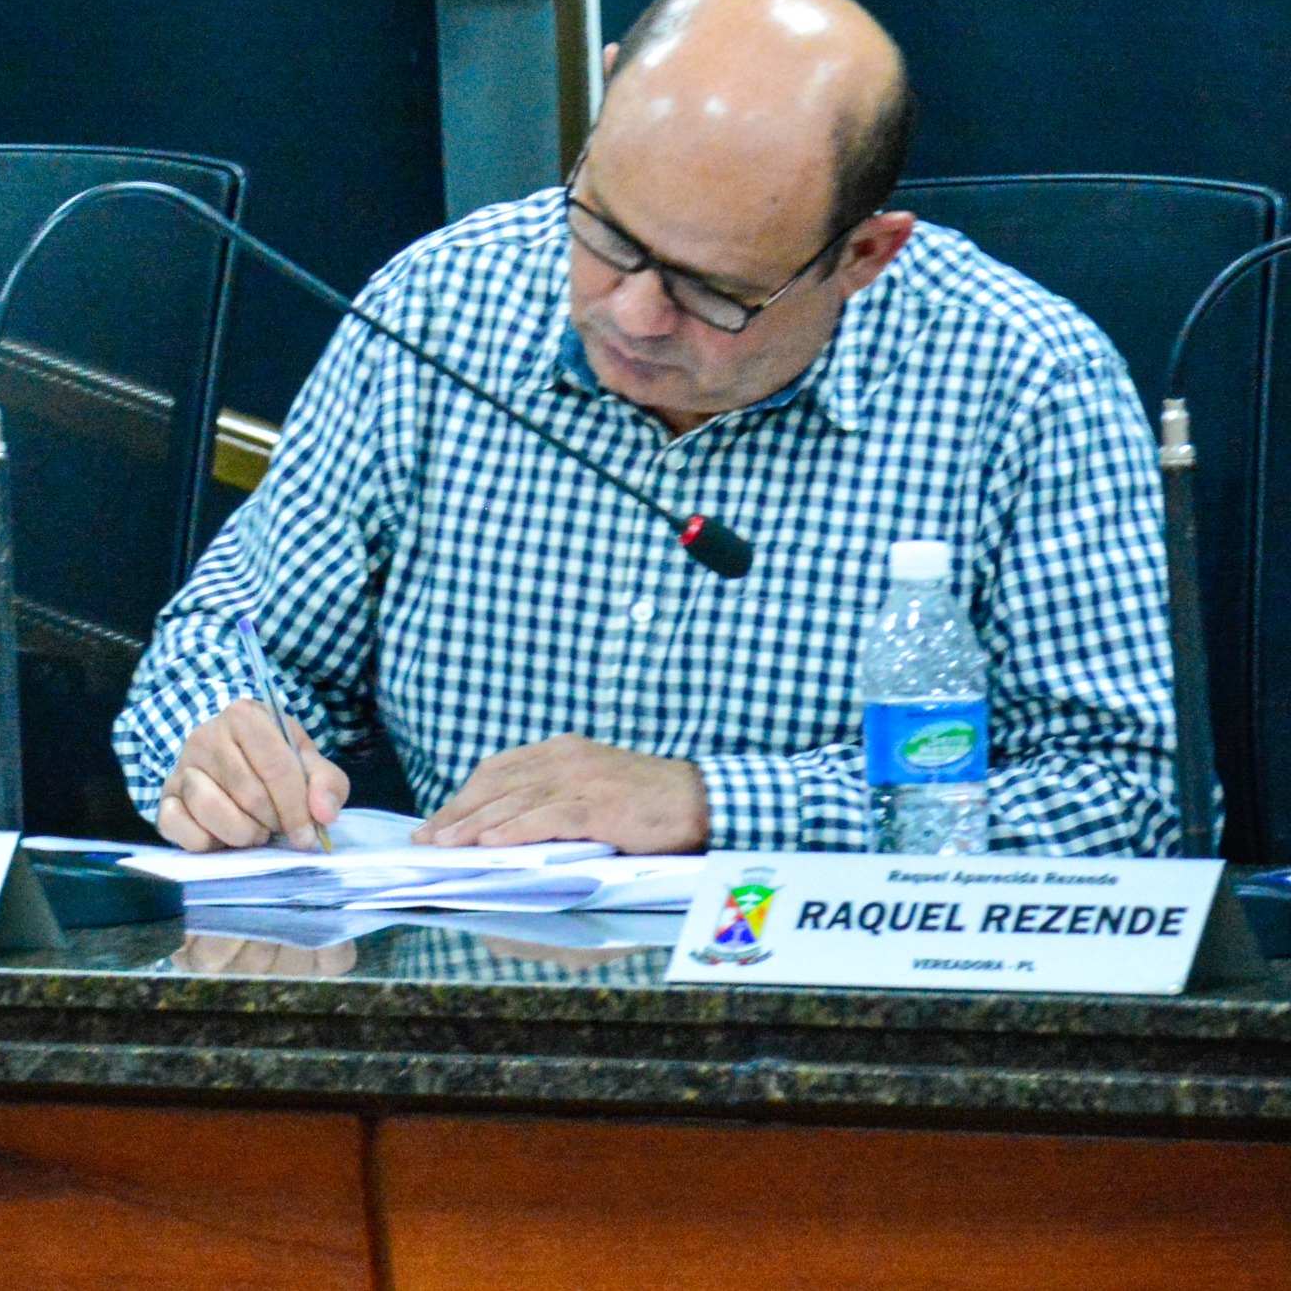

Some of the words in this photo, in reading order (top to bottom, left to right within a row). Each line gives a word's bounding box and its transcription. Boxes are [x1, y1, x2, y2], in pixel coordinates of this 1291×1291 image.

[887, 869, 950, 886] Raquel
[951, 870, 1040, 887] Aparecida
[1043, 871, 1119, 886] Rezende
[796, 899, 965, 936] RAQUEL
[977, 902, 1189, 937] REZENDE
[913, 959, 1003, 971] VEREADORA
[1016, 960, 1034, 972] PL
